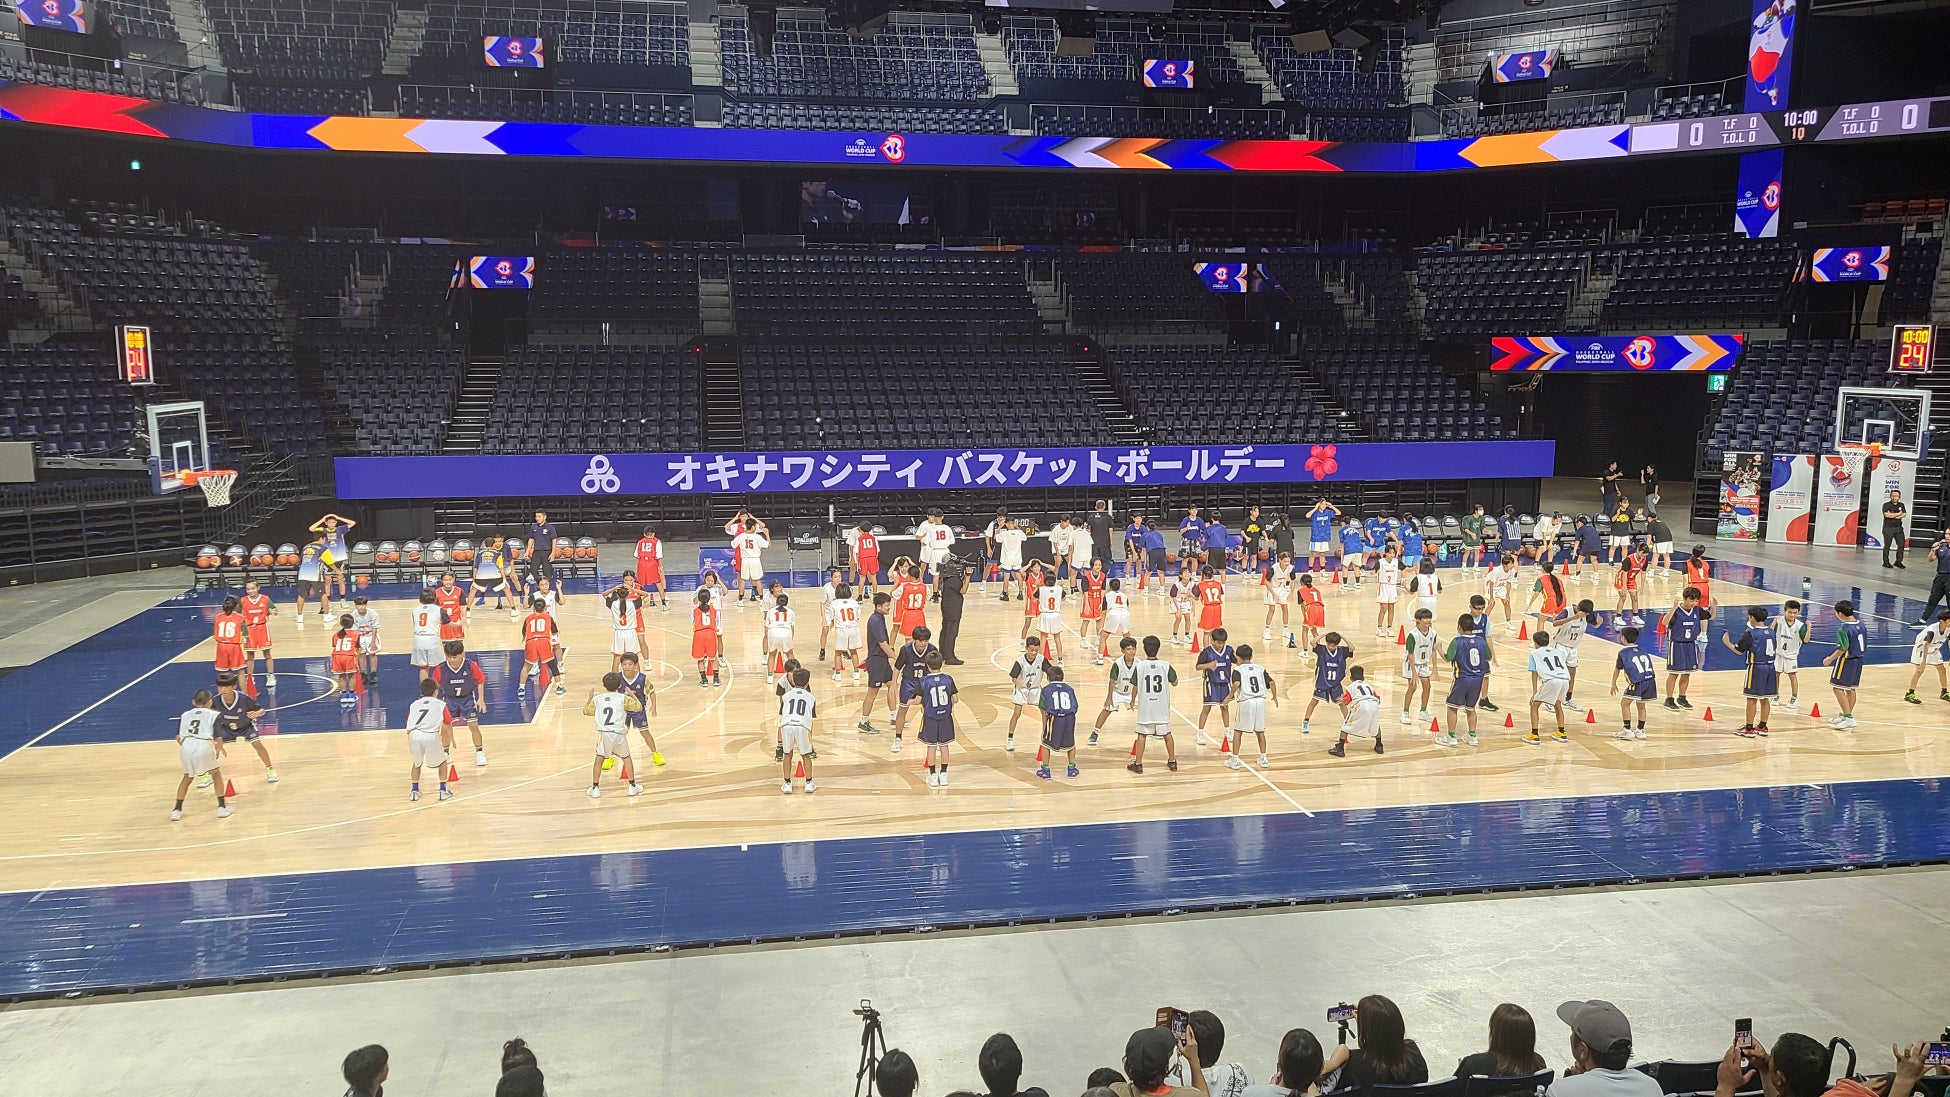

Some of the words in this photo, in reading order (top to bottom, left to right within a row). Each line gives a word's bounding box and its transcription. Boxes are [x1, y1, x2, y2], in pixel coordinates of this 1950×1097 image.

[1784, 110, 1818, 126] 10:00
[1843, 108, 1859, 120] T.F
[1871, 106, 1880, 118] 0
[1902, 104, 1918, 130] 0
[1722, 118, 1738, 130] T.F
[1750, 116, 1758, 129] 0
[1842, 123, 1866, 135] T.O.L
[1870, 121, 1878, 133] 0
[1690, 122, 1704, 146] 0
[1722, 132, 1744, 144] T.O.L
[1748, 131, 1756, 142] 0
[1791, 127, 1805, 140] 1Q
[1904, 330, 1928, 344] 10:00
[1899, 344, 1924, 367] 24
[666, 454, 923, 490] オキナワシティ
[936, 445, 1285, 486] バスケットボールデー
[642, 542, 653, 552] 12
[745, 539, 753, 549] 15
[862, 538, 873, 548] 10
[1205, 588, 1220, 602] 12
[1428, 582, 1433, 595] 1
[908, 593, 922, 608] 13
[1048, 597, 1055, 610] 8
[1115, 596, 1124, 605] 4
[419, 612, 428, 627] 9
[619, 614, 627, 626] 3
[774, 611, 787, 622] 11
[840, 608, 854, 622] 16
[218, 621, 236, 638] 16
[530, 618, 546, 632] 10
[1766, 638, 1775, 656] 4
[1858, 634, 1864, 652] 1
[1470, 648, 1480, 666] 6
[1543, 656, 1564, 671] 14
[1632, 654, 1653, 674] 12
[914, 669, 923, 678] 13
[1219, 671, 1225, 680] 8
[1328, 670, 1336, 680] 11
[1145, 675, 1162, 693] 13
[1250, 676, 1259, 693] 9
[1357, 685, 1374, 695] 11
[455, 687, 461, 696] 7
[930, 685, 948, 708] 15
[789, 699, 806, 716] 10
[1052, 691, 1071, 710] 16
[415, 709, 429, 725] 7
[603, 707, 614, 726] 2
[188, 720, 200, 734] 3
